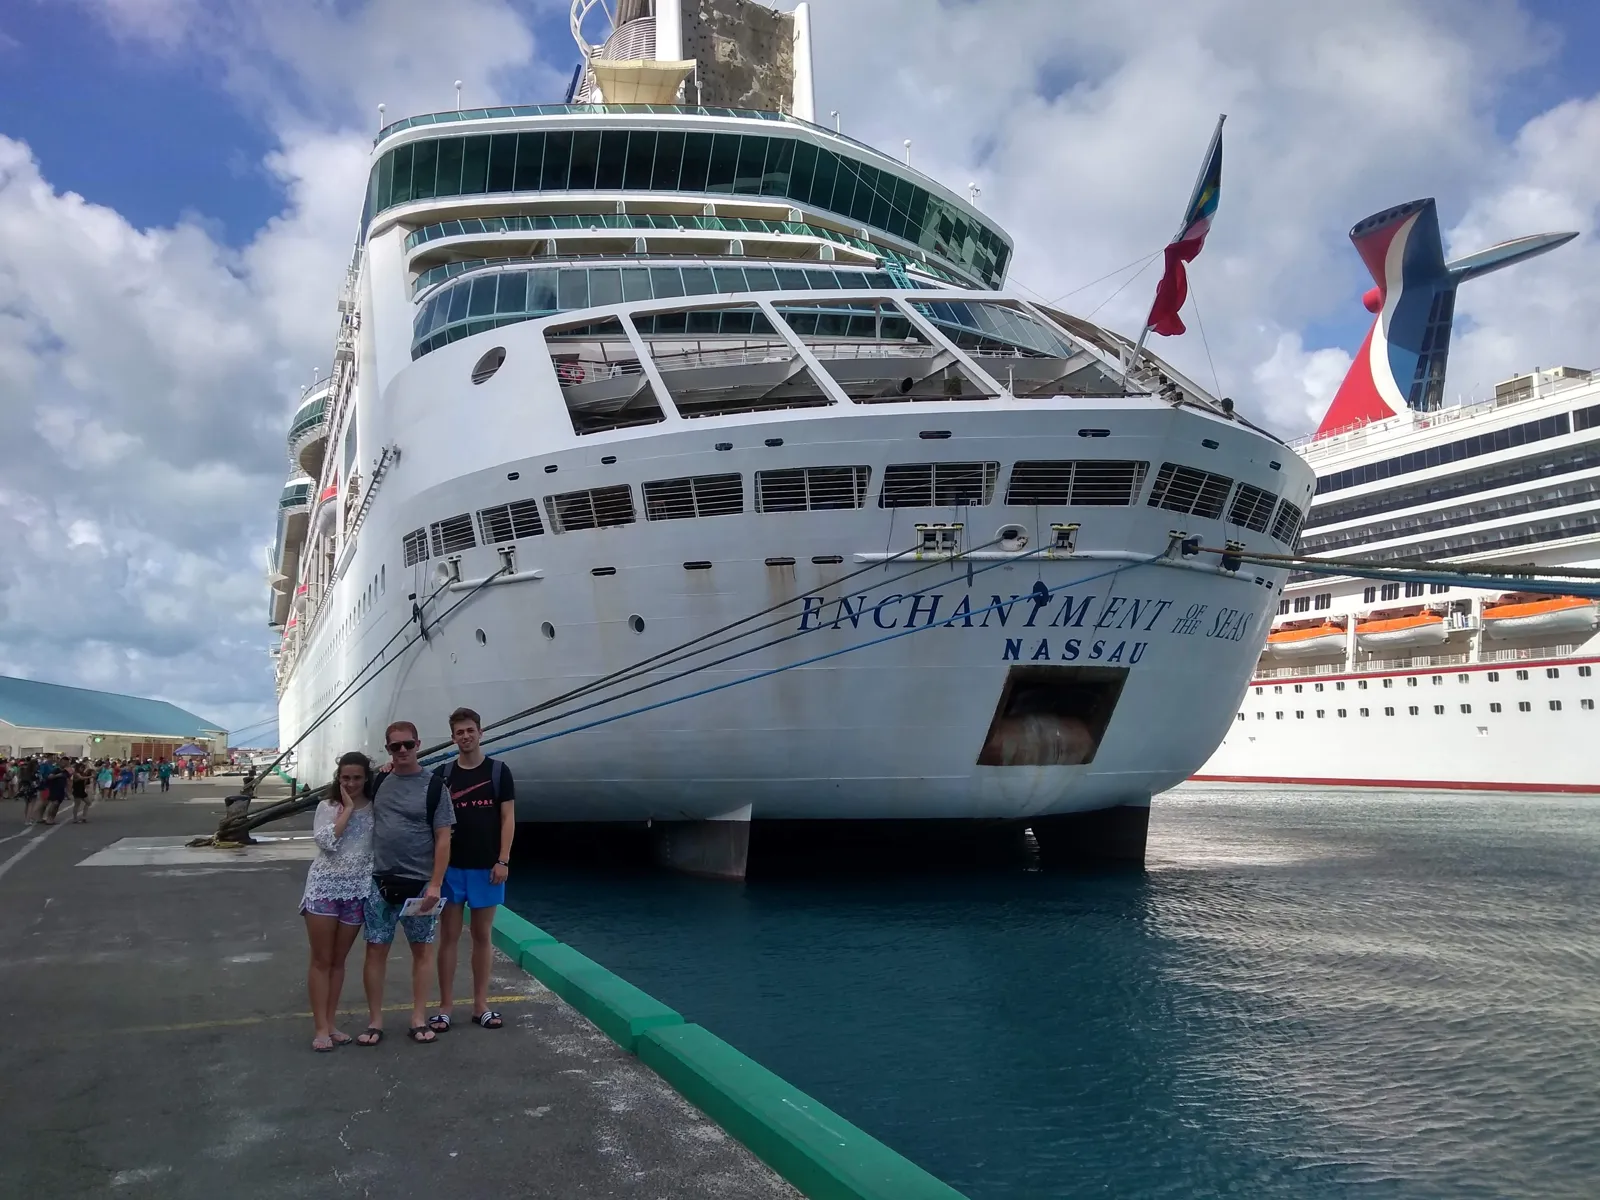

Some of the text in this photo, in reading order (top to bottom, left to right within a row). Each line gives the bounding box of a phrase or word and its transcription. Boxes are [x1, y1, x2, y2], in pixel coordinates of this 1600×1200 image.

[797, 594, 1254, 642] ENCHANTMENT OF THE SEAS
[1002, 638, 1148, 664] NASSAU
